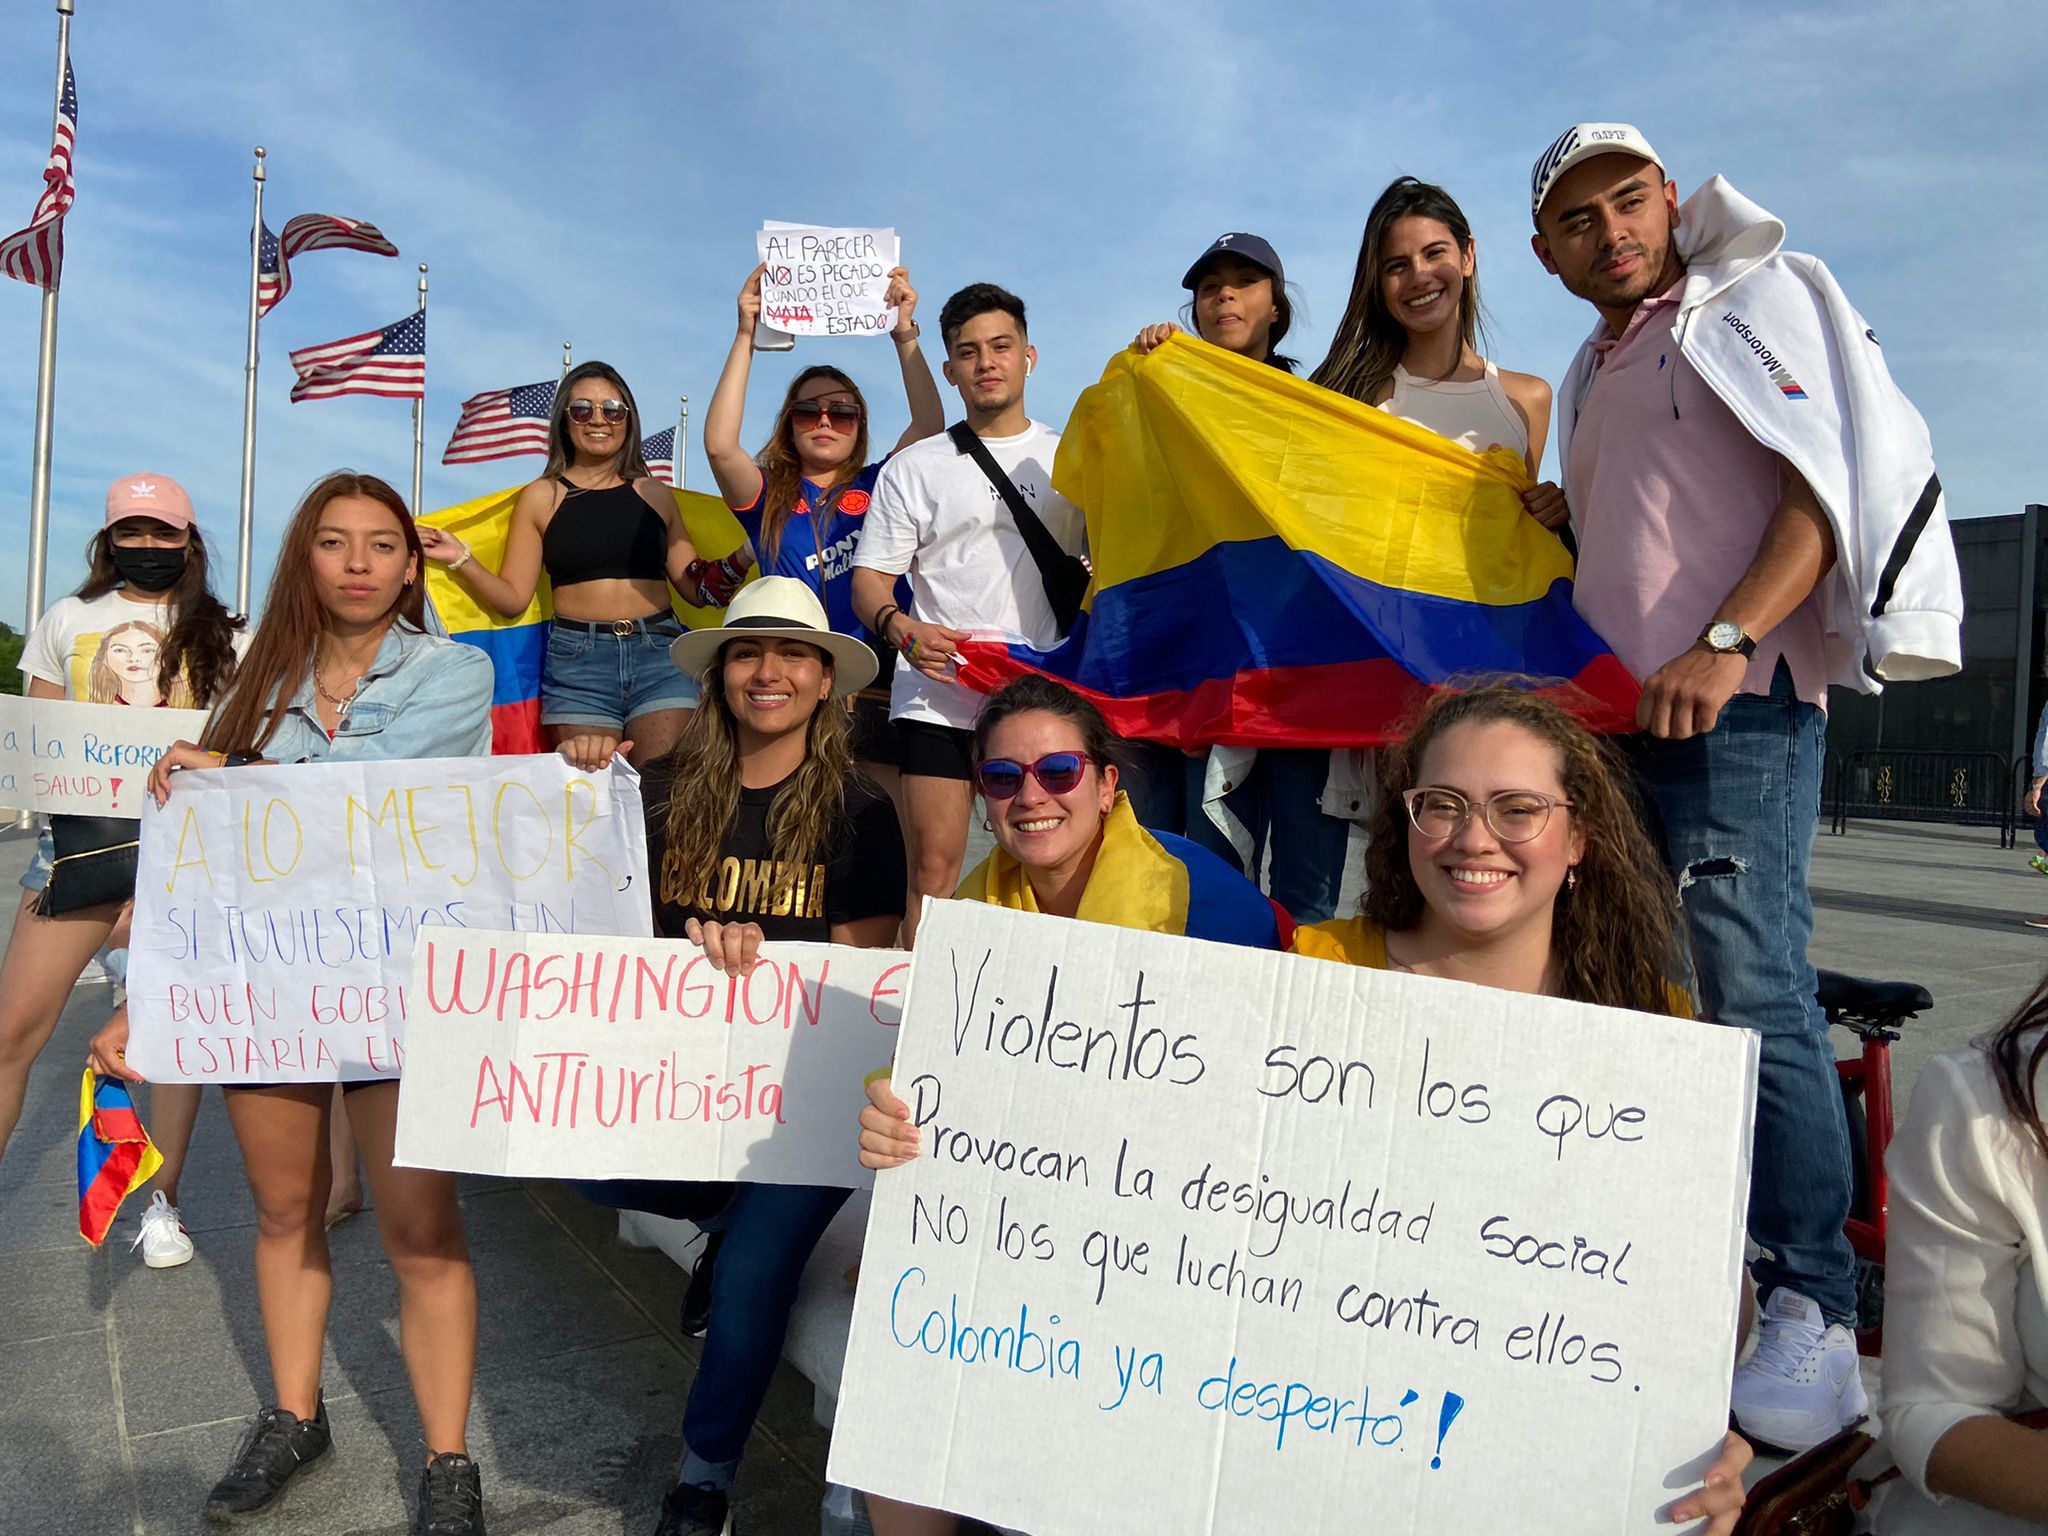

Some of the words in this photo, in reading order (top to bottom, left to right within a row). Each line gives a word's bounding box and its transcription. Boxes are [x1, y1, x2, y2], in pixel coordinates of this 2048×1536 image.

[766, 236, 795, 261] AL
[801, 235, 877, 262] PARECER
[764, 265, 792, 287] NO
[798, 264, 816, 284] ES
[821, 263, 883, 283] PECADO
[764, 287, 817, 303] CUANDO
[840, 282, 869, 299] QUE
[766, 305, 813, 319] MATA
[815, 302, 833, 318] ES
[826, 314, 888, 334] ESTADO
[1722, 312, 1781, 372] Motorsport
[823, 551, 854, 582] Malt
[0, 773, 17, 792] a
[166, 806, 215, 893] A
[245, 798, 303, 883] LO
[347, 778, 632, 891] MEJOR,
[660, 848, 825, 918] CLOMBIA
[168, 907, 198, 960] SI
[170, 981, 276, 1026] BUEN
[428, 941, 830, 1029] WASHINGTON
[175, 1029, 338, 1076] ESTARÍA
[950, 948, 1206, 1085] Violentos
[1256, 1045, 1375, 1109] son
[1417, 1037, 1491, 1124] los
[911, 1074, 1089, 1187] Provocan
[1181, 1163, 1435, 1258] desigualdad
[996, 1197, 1055, 1260] los
[1082, 1230, 1149, 1306] que
[1176, 1234, 1302, 1312] luchan
[1337, 1283, 1479, 1350] contra
[1505, 1312, 1640, 1391] ellos.
[891, 1266, 1080, 1380] Colombia
[1099, 1344, 1164, 1411] ya
